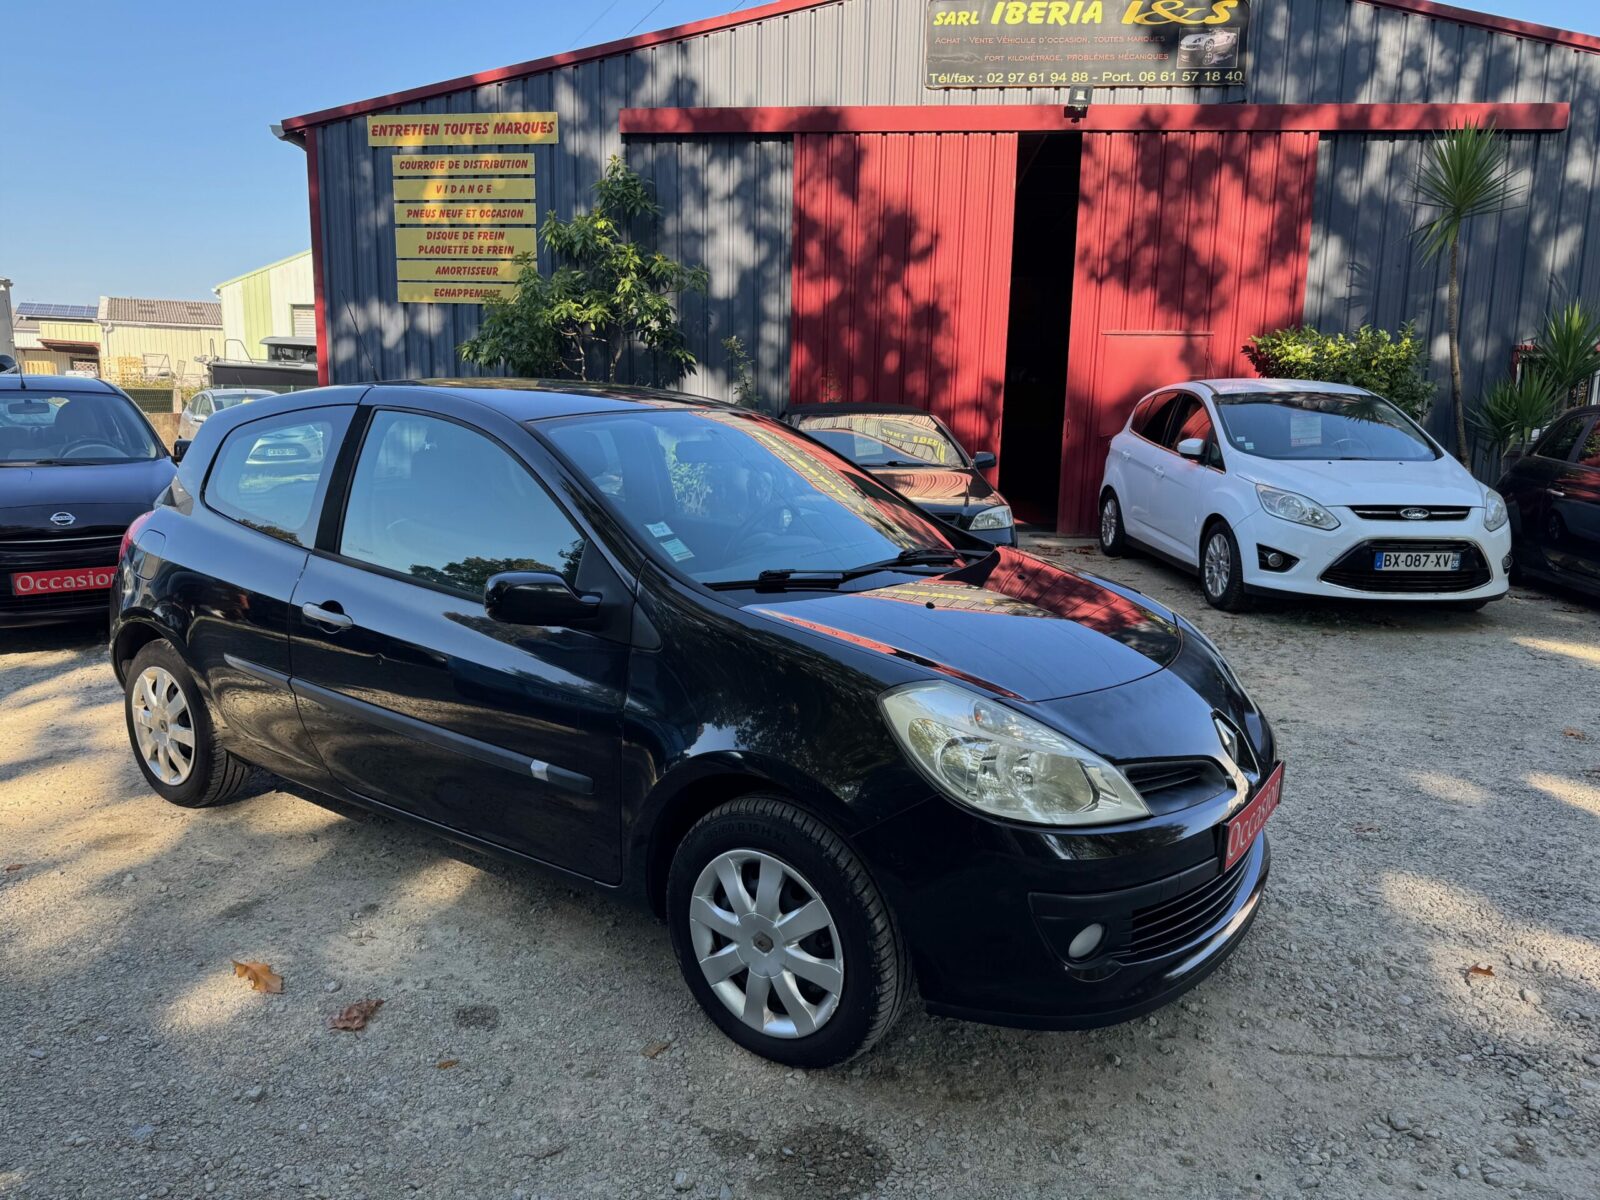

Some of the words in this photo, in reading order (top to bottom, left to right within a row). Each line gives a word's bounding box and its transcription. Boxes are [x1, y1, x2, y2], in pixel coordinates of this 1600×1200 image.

[933, 11, 980, 26] SARL
[990, 1, 1103, 26] IBERIA
[929, 72, 975, 83] Tél/fax
[987, 73, 1004, 82] 02
[1008, 73, 1026, 83] 97
[1029, 73, 1045, 82] 61
[1051, 72, 1067, 83] 94
[1072, 72, 1089, 82] 88
[1102, 72, 1134, 82] Port.
[1138, 72, 1156, 82] 06
[1160, 72, 1176, 82] 61
[1182, 72, 1199, 82] 57
[1204, 72, 1220, 81] 18
[1225, 71, 1242, 81] 40
[371, 124, 439, 137] ENTRETIEN
[444, 122, 489, 135] TOUTES
[493, 121, 555, 135] MARQUES
[399, 160, 445, 170] COURROIE
[448, 160, 460, 170] DE
[463, 159, 529, 169] DISTRIBUTION
[436, 184, 493, 194] VIDANGE
[407, 209, 436, 218] PNEUS
[439, 209, 463, 218] NEUF
[466, 209, 478, 218] ET
[479, 209, 524, 218] OCCASION
[426, 231, 460, 240] DISQUE
[462, 231, 475, 240] DE
[477, 231, 505, 240] FREIN
[418, 245, 469, 254] PLAQUETTE
[471, 245, 485, 254] DE
[486, 245, 515, 254] FREIN
[435, 266, 499, 276] AMORTISSEUR
[1384, 554, 1451, 568] BX-087-XV
[1228, 778, 1281, 858] Occasion
